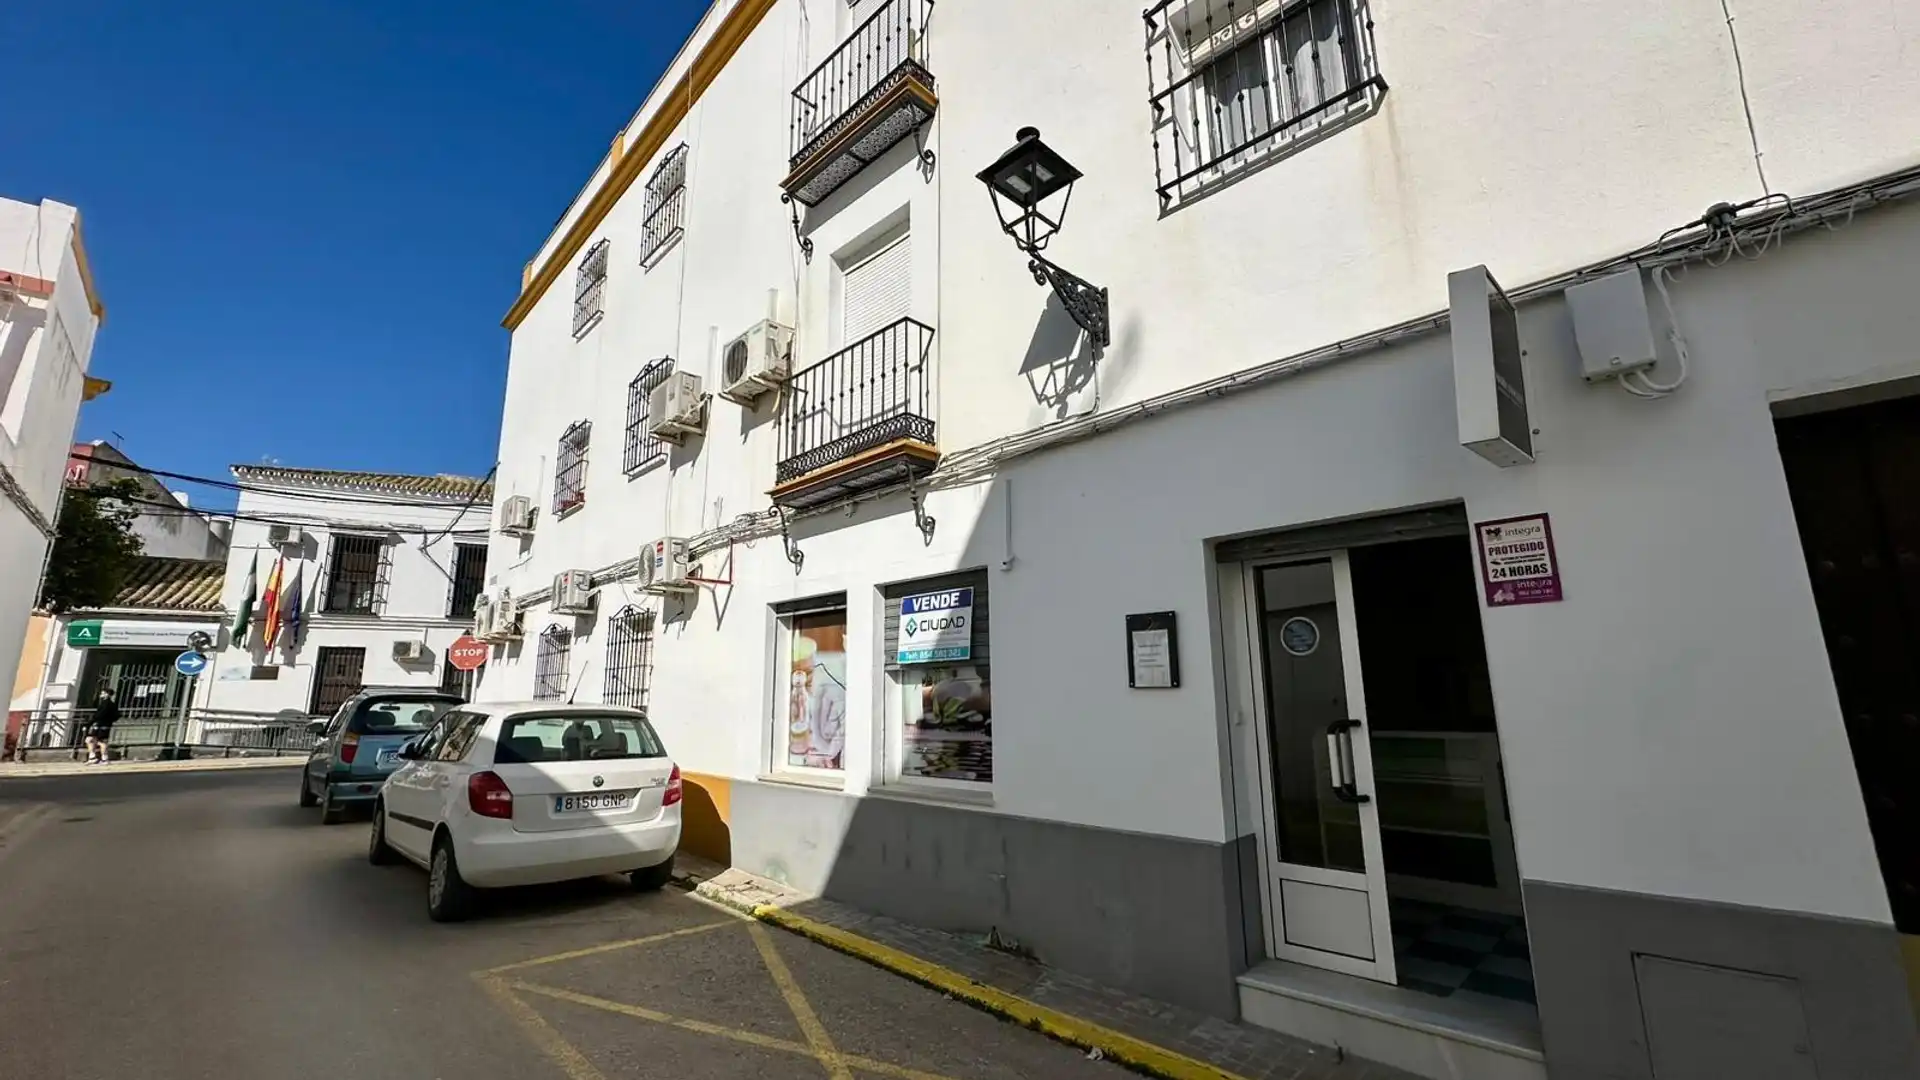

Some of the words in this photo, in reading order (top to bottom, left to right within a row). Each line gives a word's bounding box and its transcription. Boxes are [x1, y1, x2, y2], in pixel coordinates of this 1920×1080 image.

[1504, 525, 1541, 537] integra
[1488, 541, 1545, 556] PROTEGIDO
[1491, 568, 1507, 579] 24
[1509, 563, 1548, 577] HORAS
[912, 592, 960, 611] VENDE
[920, 616, 965, 632] CIUDAD
[453, 648, 484, 657] STOP
[565, 796, 598, 810] 8150
[602, 793, 626, 807] GNP
